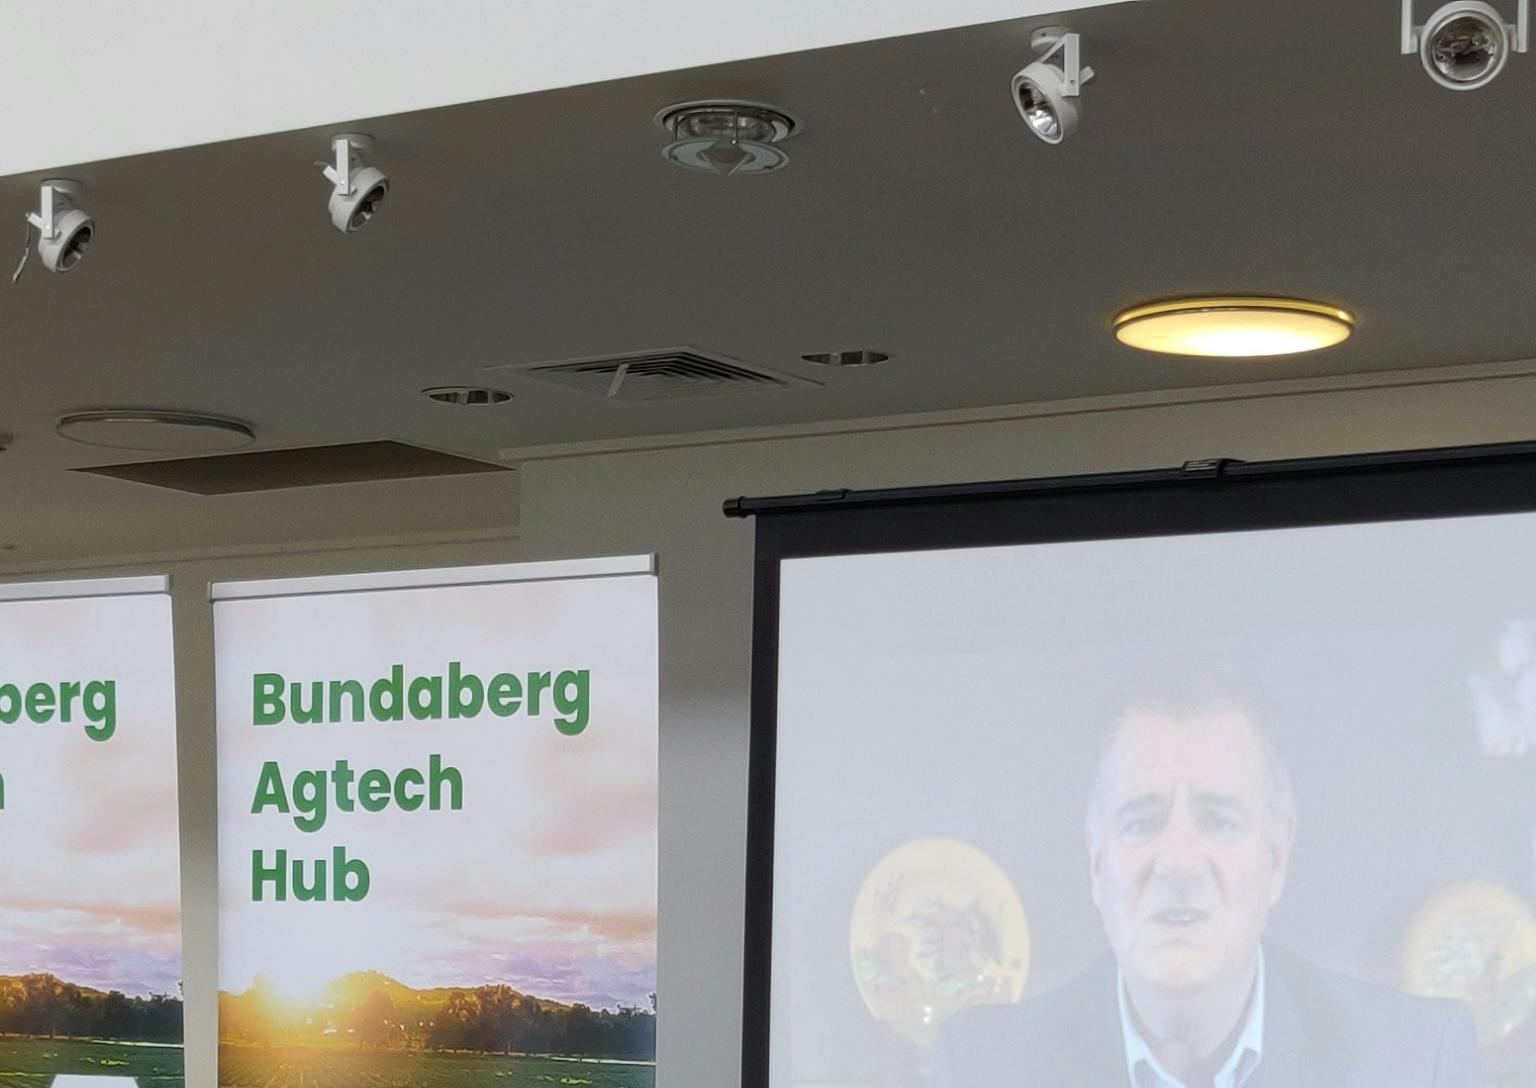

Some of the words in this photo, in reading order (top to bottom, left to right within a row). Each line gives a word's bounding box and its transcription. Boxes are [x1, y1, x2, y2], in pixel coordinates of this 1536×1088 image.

[251, 662, 590, 736] Bundaberg
[250, 754, 464, 833] Agtech
[251, 846, 370, 902] Hub
